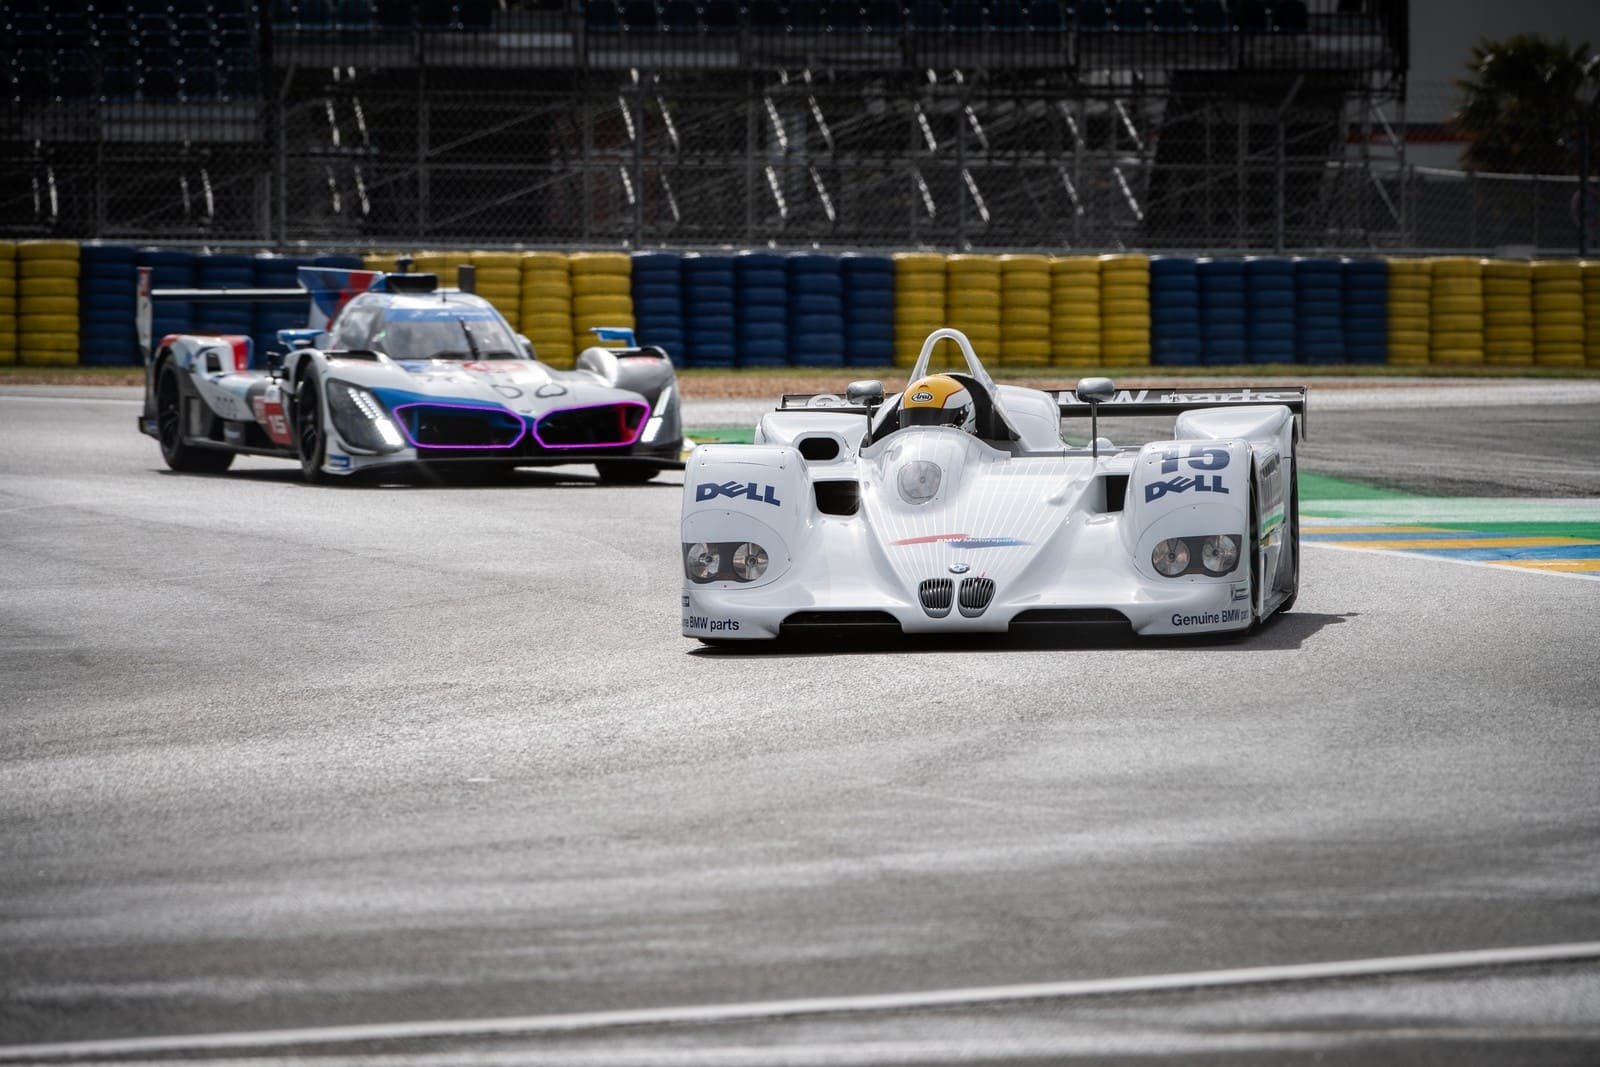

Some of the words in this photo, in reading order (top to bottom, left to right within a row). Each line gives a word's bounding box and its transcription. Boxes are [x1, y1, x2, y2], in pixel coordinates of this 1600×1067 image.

[269, 416, 289, 434] 15
[1159, 444, 1230, 474] 15
[695, 480, 781, 507] DELL
[1145, 475, 1229, 503] DELL
[689, 616, 708, 629] BMW
[710, 618, 740, 632] parts
[1171, 611, 1220, 626] Genuine
[1221, 609, 1241, 623] BMW
